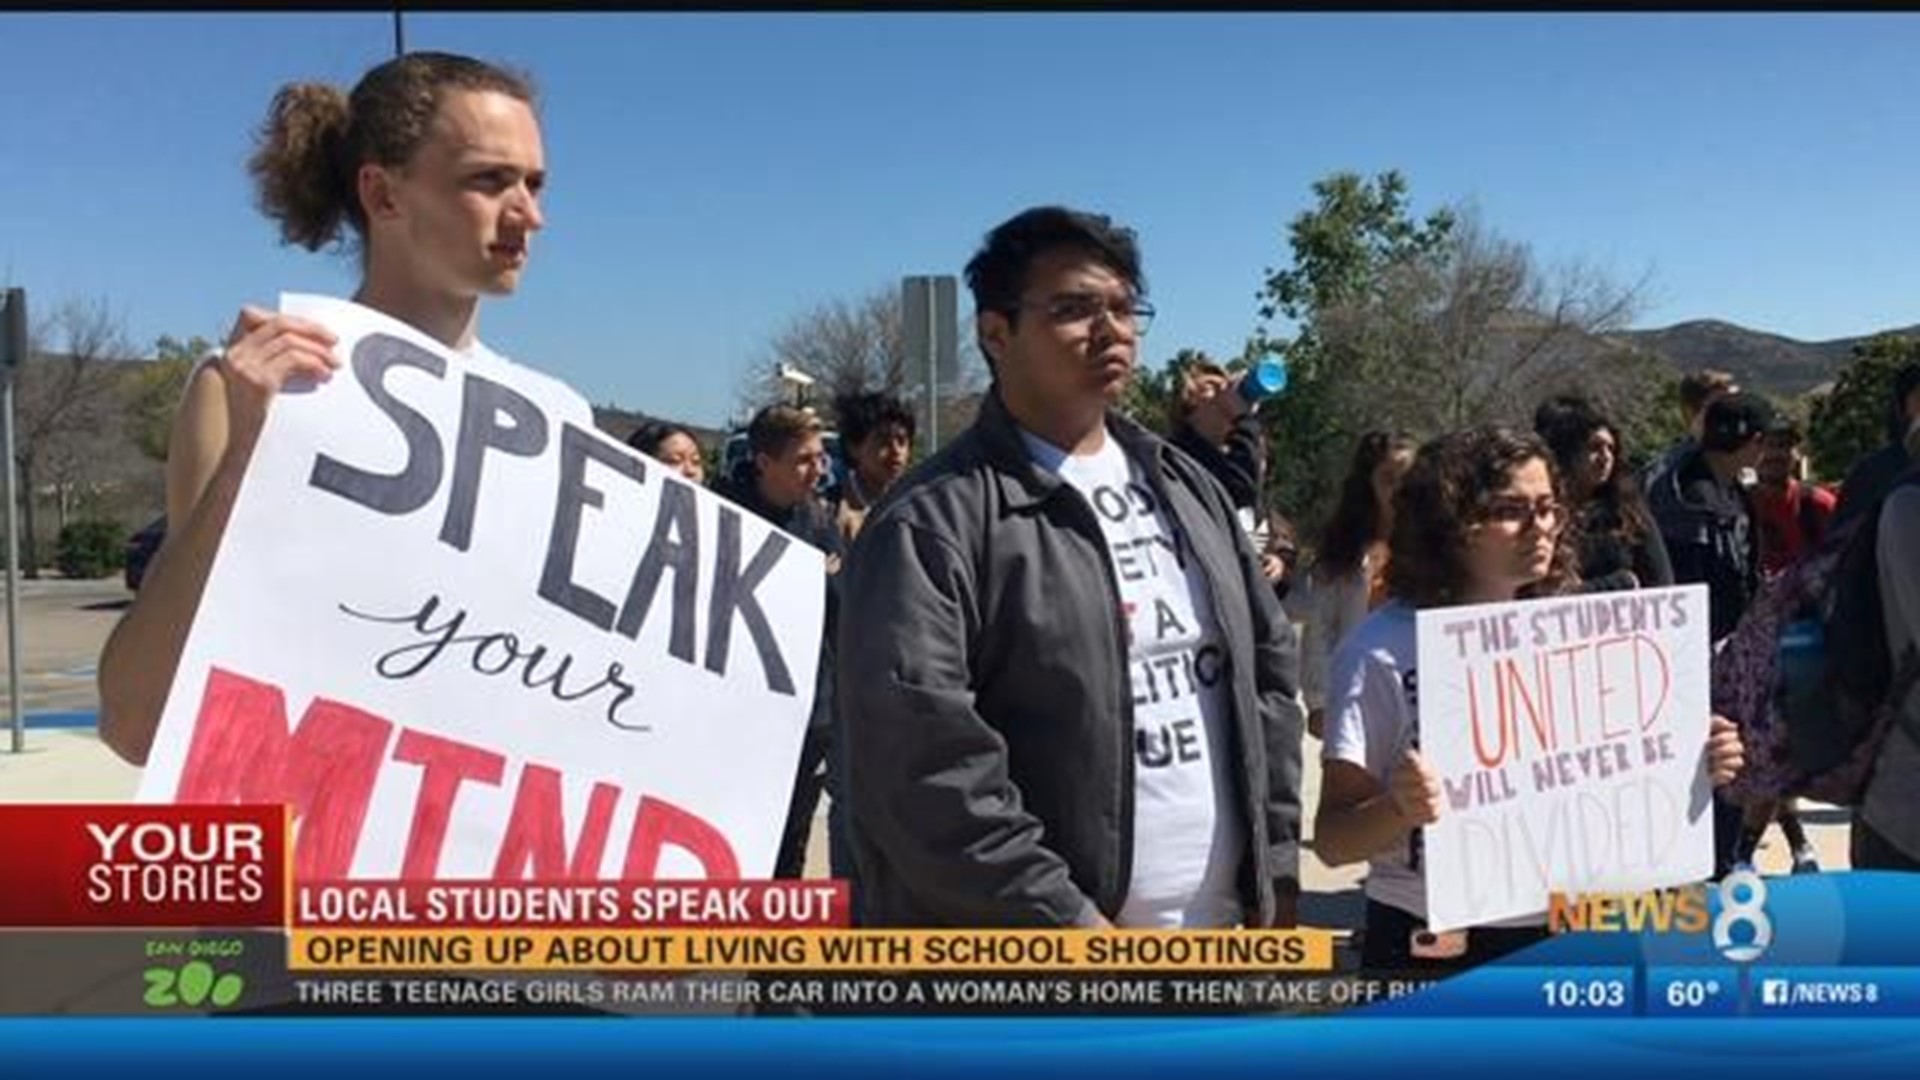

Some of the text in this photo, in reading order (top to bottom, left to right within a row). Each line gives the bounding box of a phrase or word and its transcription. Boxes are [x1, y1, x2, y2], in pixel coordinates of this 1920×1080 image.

[308, 331, 797, 697] SPEAK
[338, 594, 652, 732] your
[1443, 592, 1688, 656] THE STUDENTS
[1466, 633, 1670, 768] UNITED
[1444, 732, 1675, 811] WILL NEVER BE
[1457, 775, 1680, 918] DIVIDED
